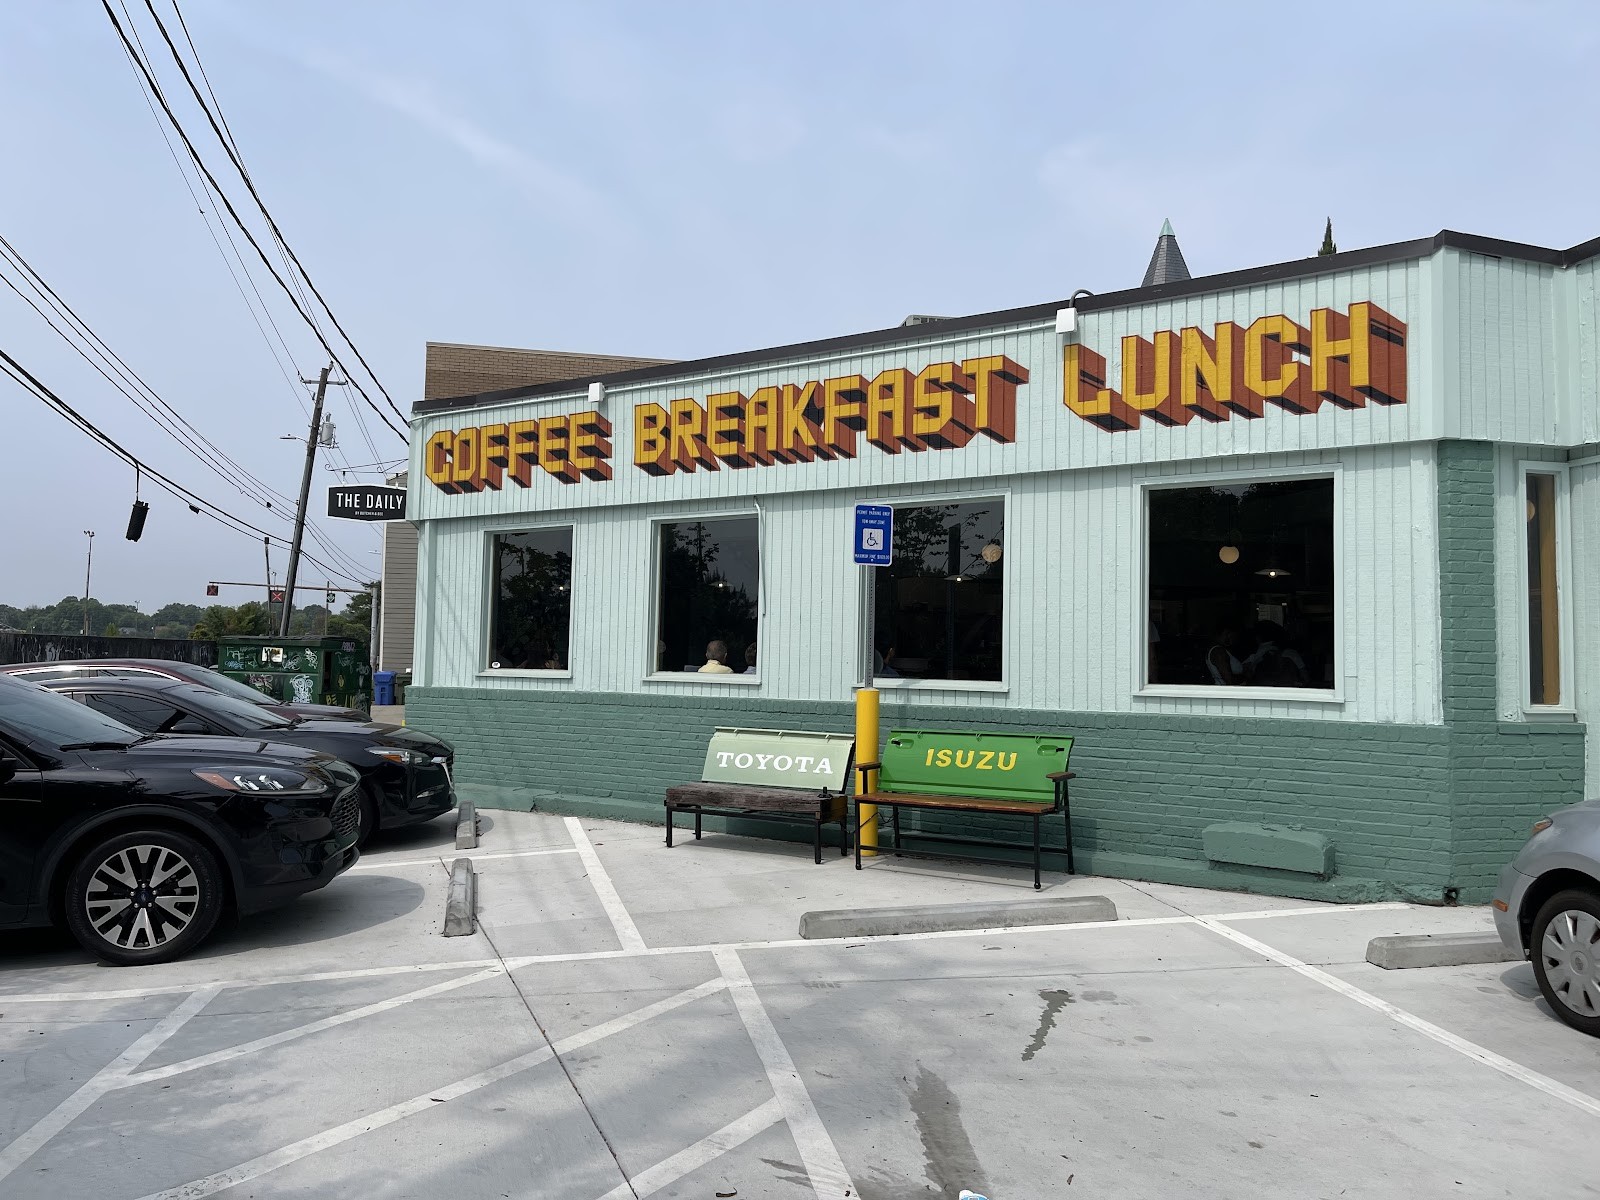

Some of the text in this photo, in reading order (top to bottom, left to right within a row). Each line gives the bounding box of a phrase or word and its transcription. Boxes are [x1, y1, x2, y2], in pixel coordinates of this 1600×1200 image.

[425, 301, 1407, 495] COFFEE BREAKFAST LUNCH
[336, 492, 404, 510] THE DAILY
[716, 752, 834, 774] TOYOTA
[924, 748, 1018, 771] ISUZU
